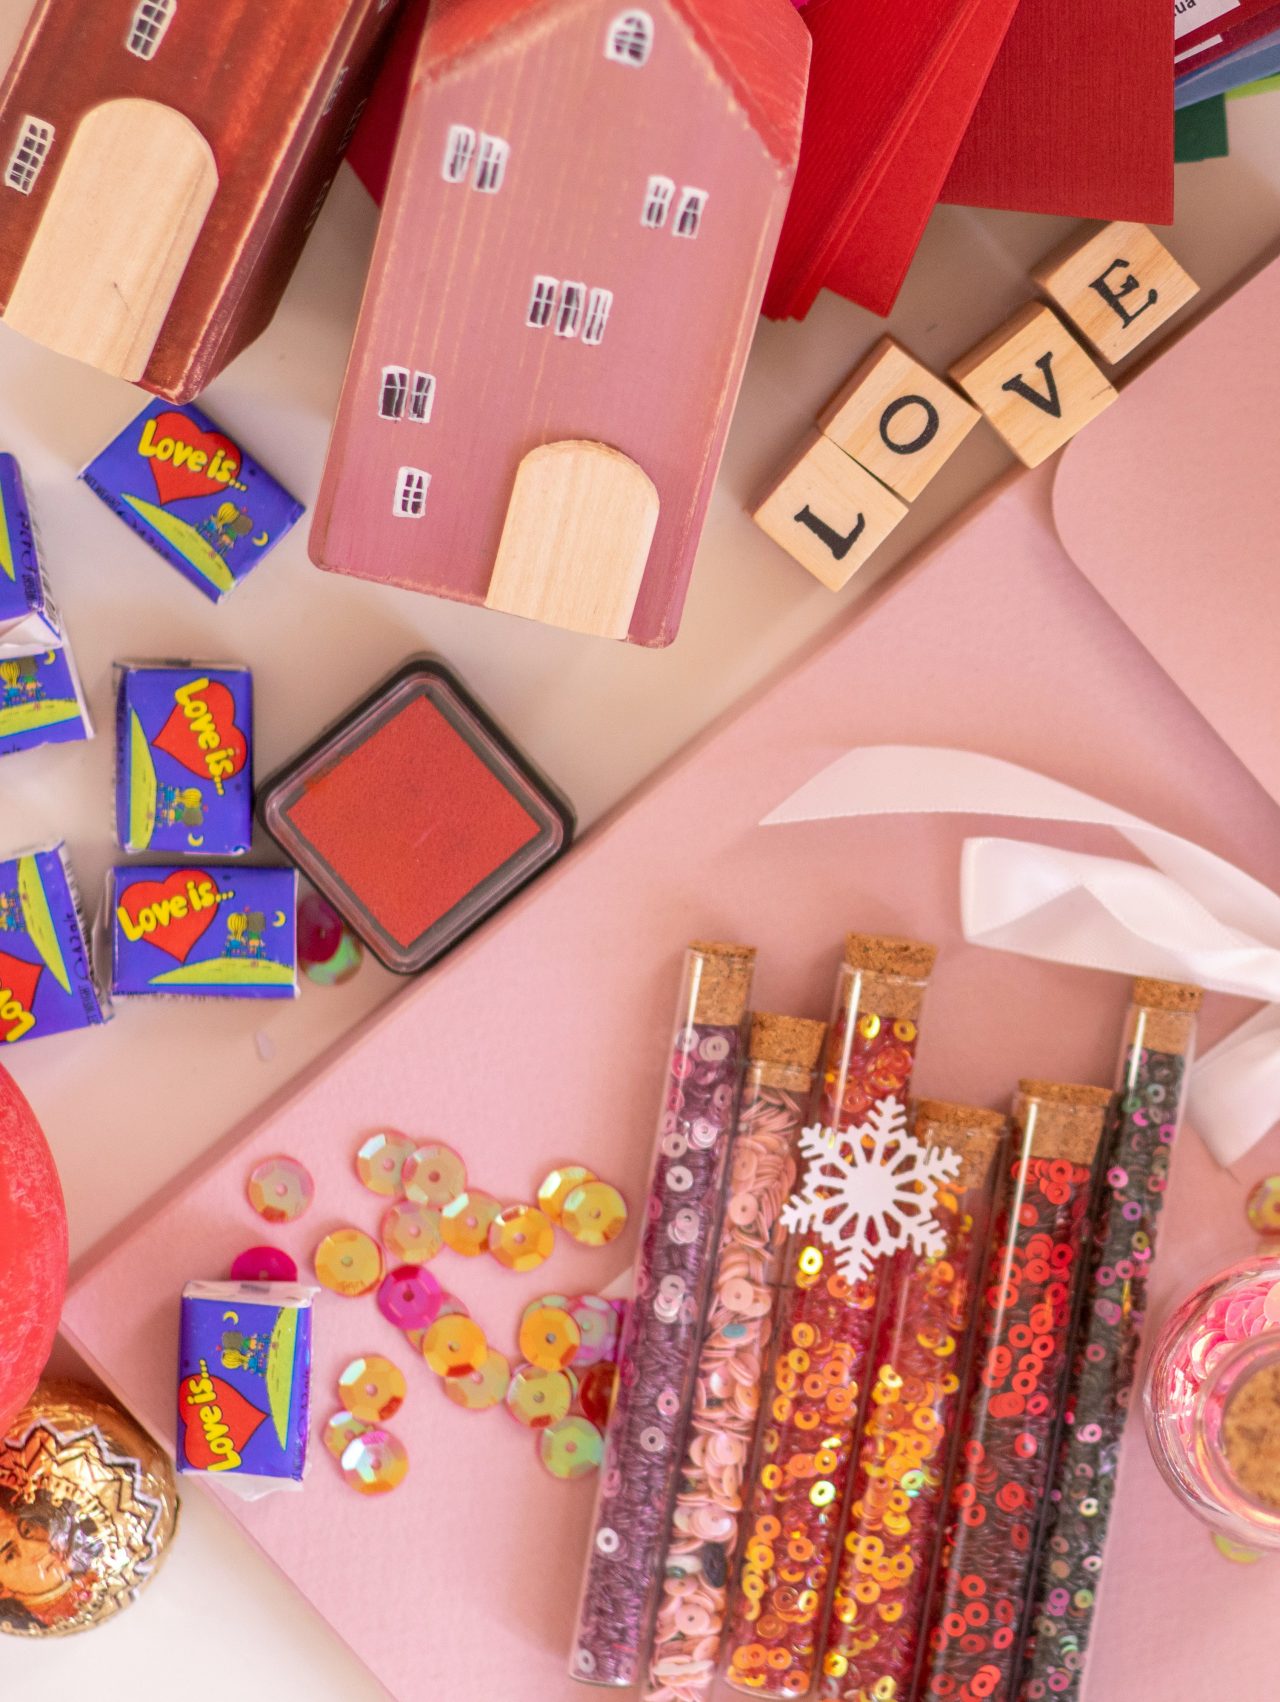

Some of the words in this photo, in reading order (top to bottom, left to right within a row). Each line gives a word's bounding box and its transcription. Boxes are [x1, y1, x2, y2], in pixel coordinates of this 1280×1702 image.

[138, 419, 208, 472] Love
[175, 677, 221, 751] Love
[117, 893, 189, 942] Love
[199, 1403, 242, 1472] Love
